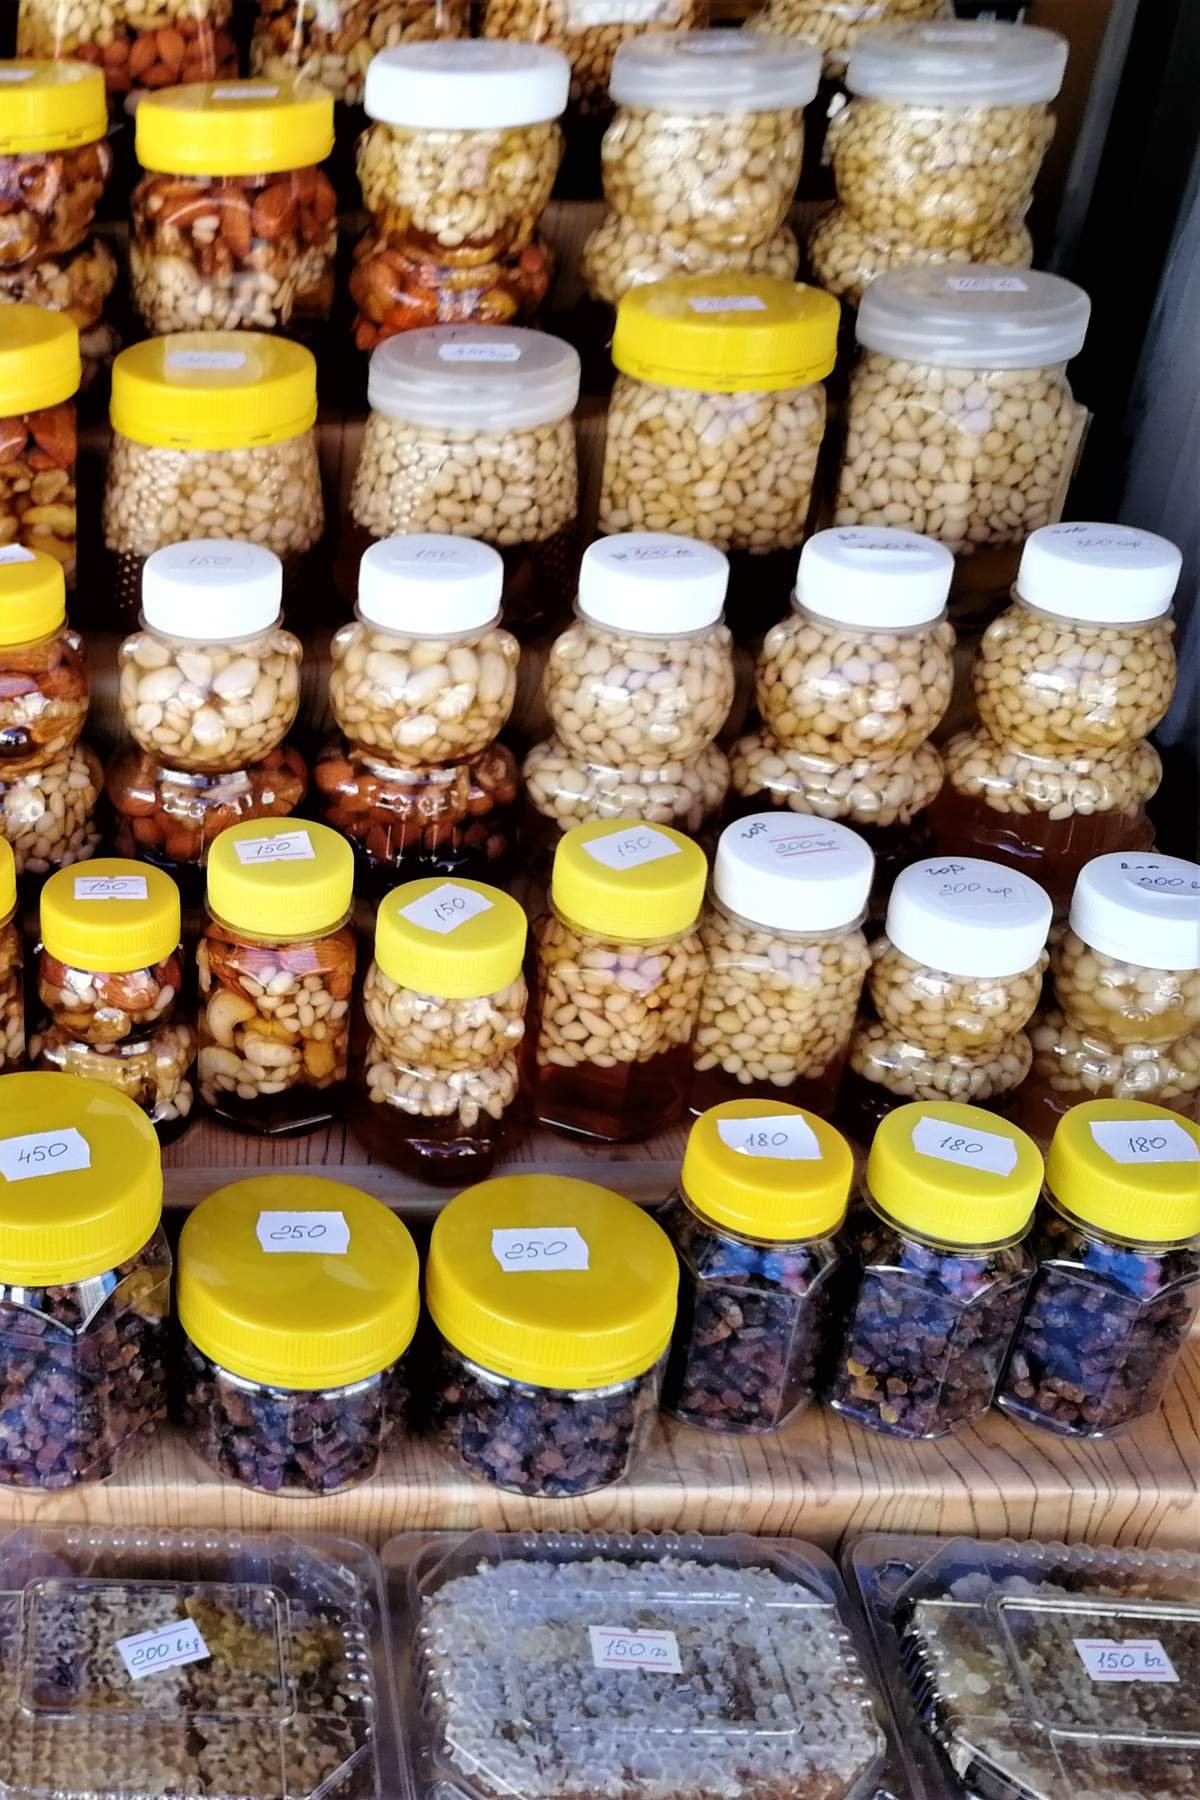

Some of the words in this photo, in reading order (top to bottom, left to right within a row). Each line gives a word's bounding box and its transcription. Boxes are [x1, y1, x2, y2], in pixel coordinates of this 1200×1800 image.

[255, 840, 291, 856] 150
[616, 836, 652, 857] 150
[88, 880, 128, 892] 150
[939, 882, 981, 896] 200
[1137, 876, 1184, 887] 200
[432, 896, 466, 922] 150
[745, 1132, 788, 1148] 180
[938, 1136, 983, 1156] 180
[1127, 1135, 1167, 1154] 180
[16, 1141, 70, 1164] 450
[270, 1223, 327, 1240] 250
[504, 1239, 568, 1259] 250
[131, 1643, 170, 1666] 200
[606, 1640, 646, 1656] 150
[1097, 1652, 1136, 1668] 150
